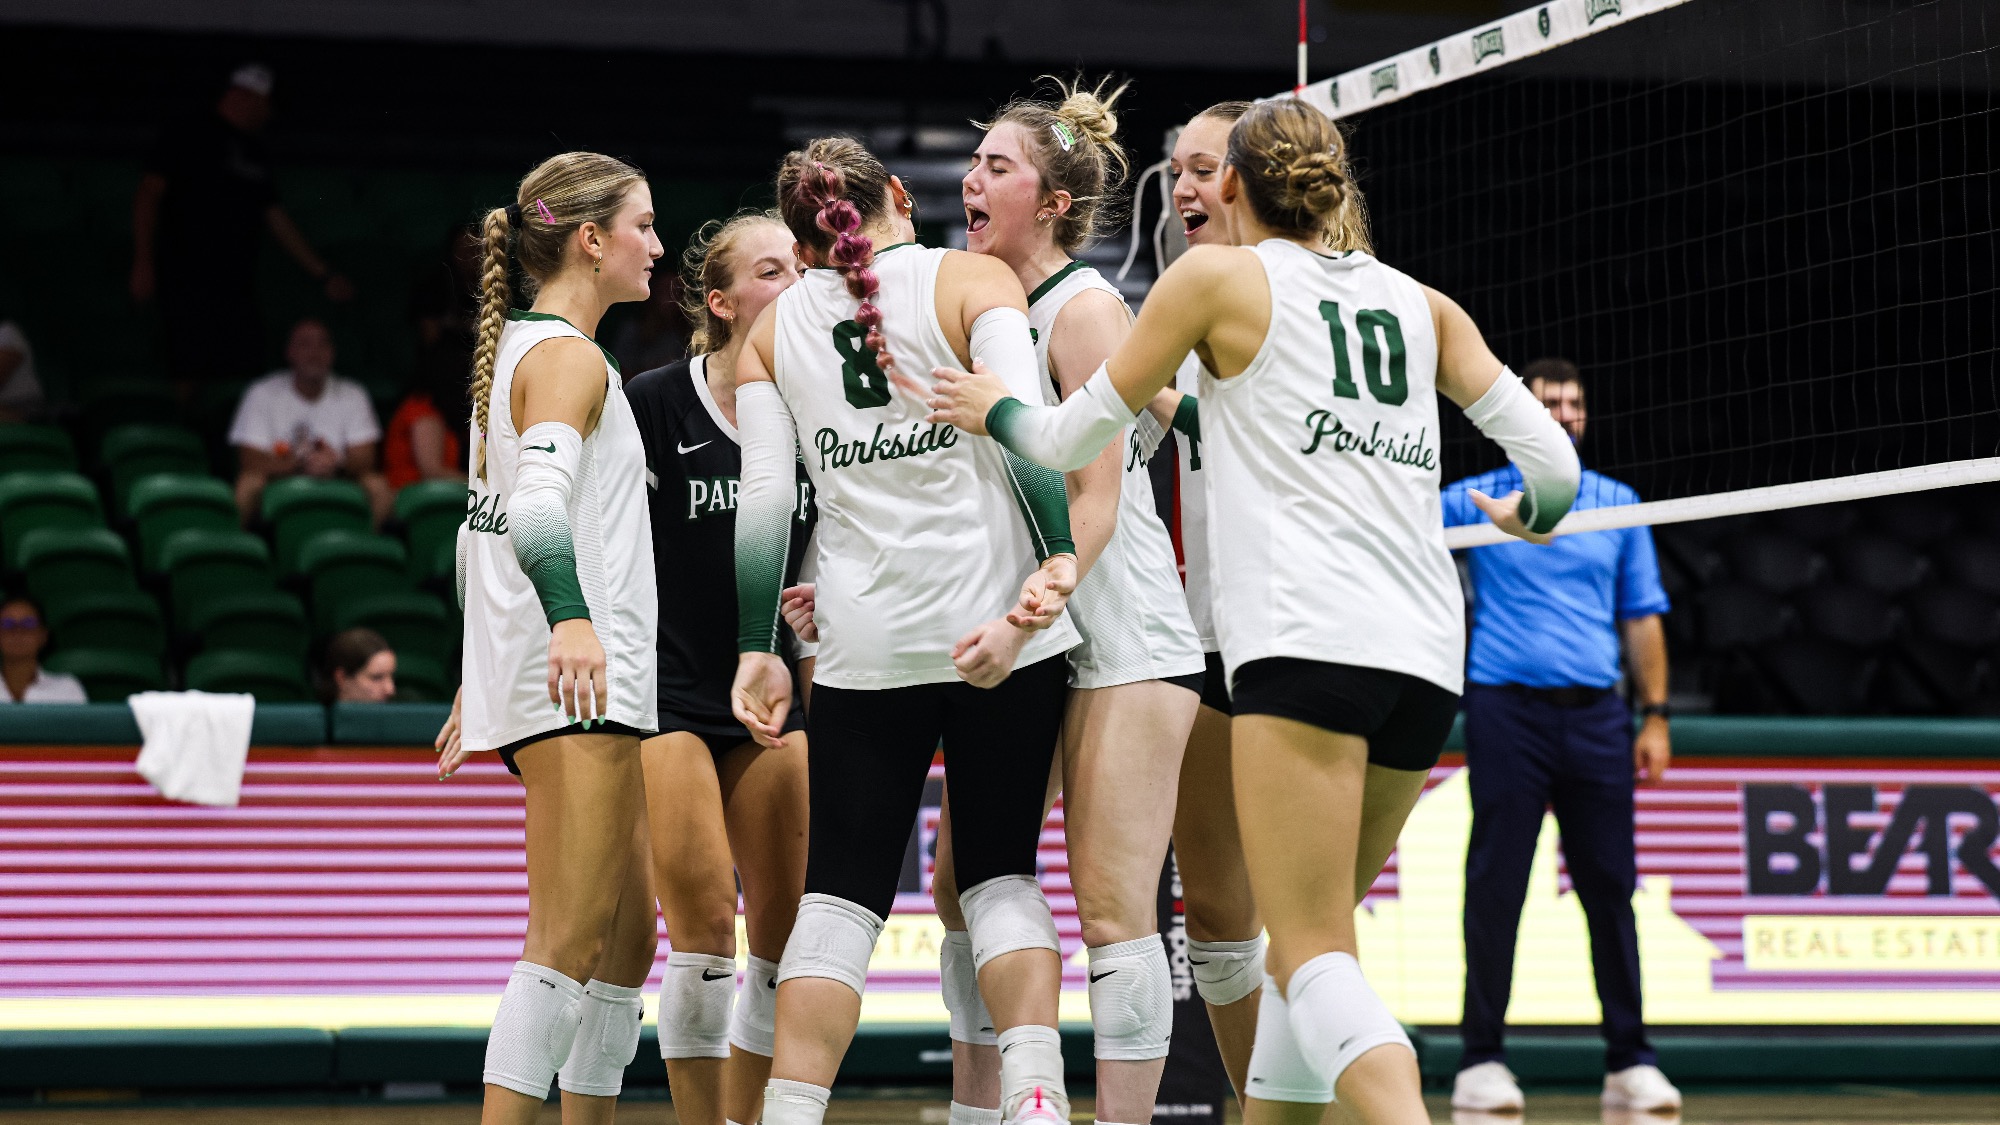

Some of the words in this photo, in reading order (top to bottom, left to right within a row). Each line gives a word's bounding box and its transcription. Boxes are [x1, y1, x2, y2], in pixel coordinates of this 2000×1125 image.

[833, 319, 892, 409] 8
[1319, 300, 1408, 406] 10
[815, 410, 958, 472] Parkside
[1301, 410, 1436, 471] Parkside
[1746, 781, 2000, 908] BEAR
[1755, 928, 1850, 959] REAL
[1871, 928, 2000, 959] ESTAT
